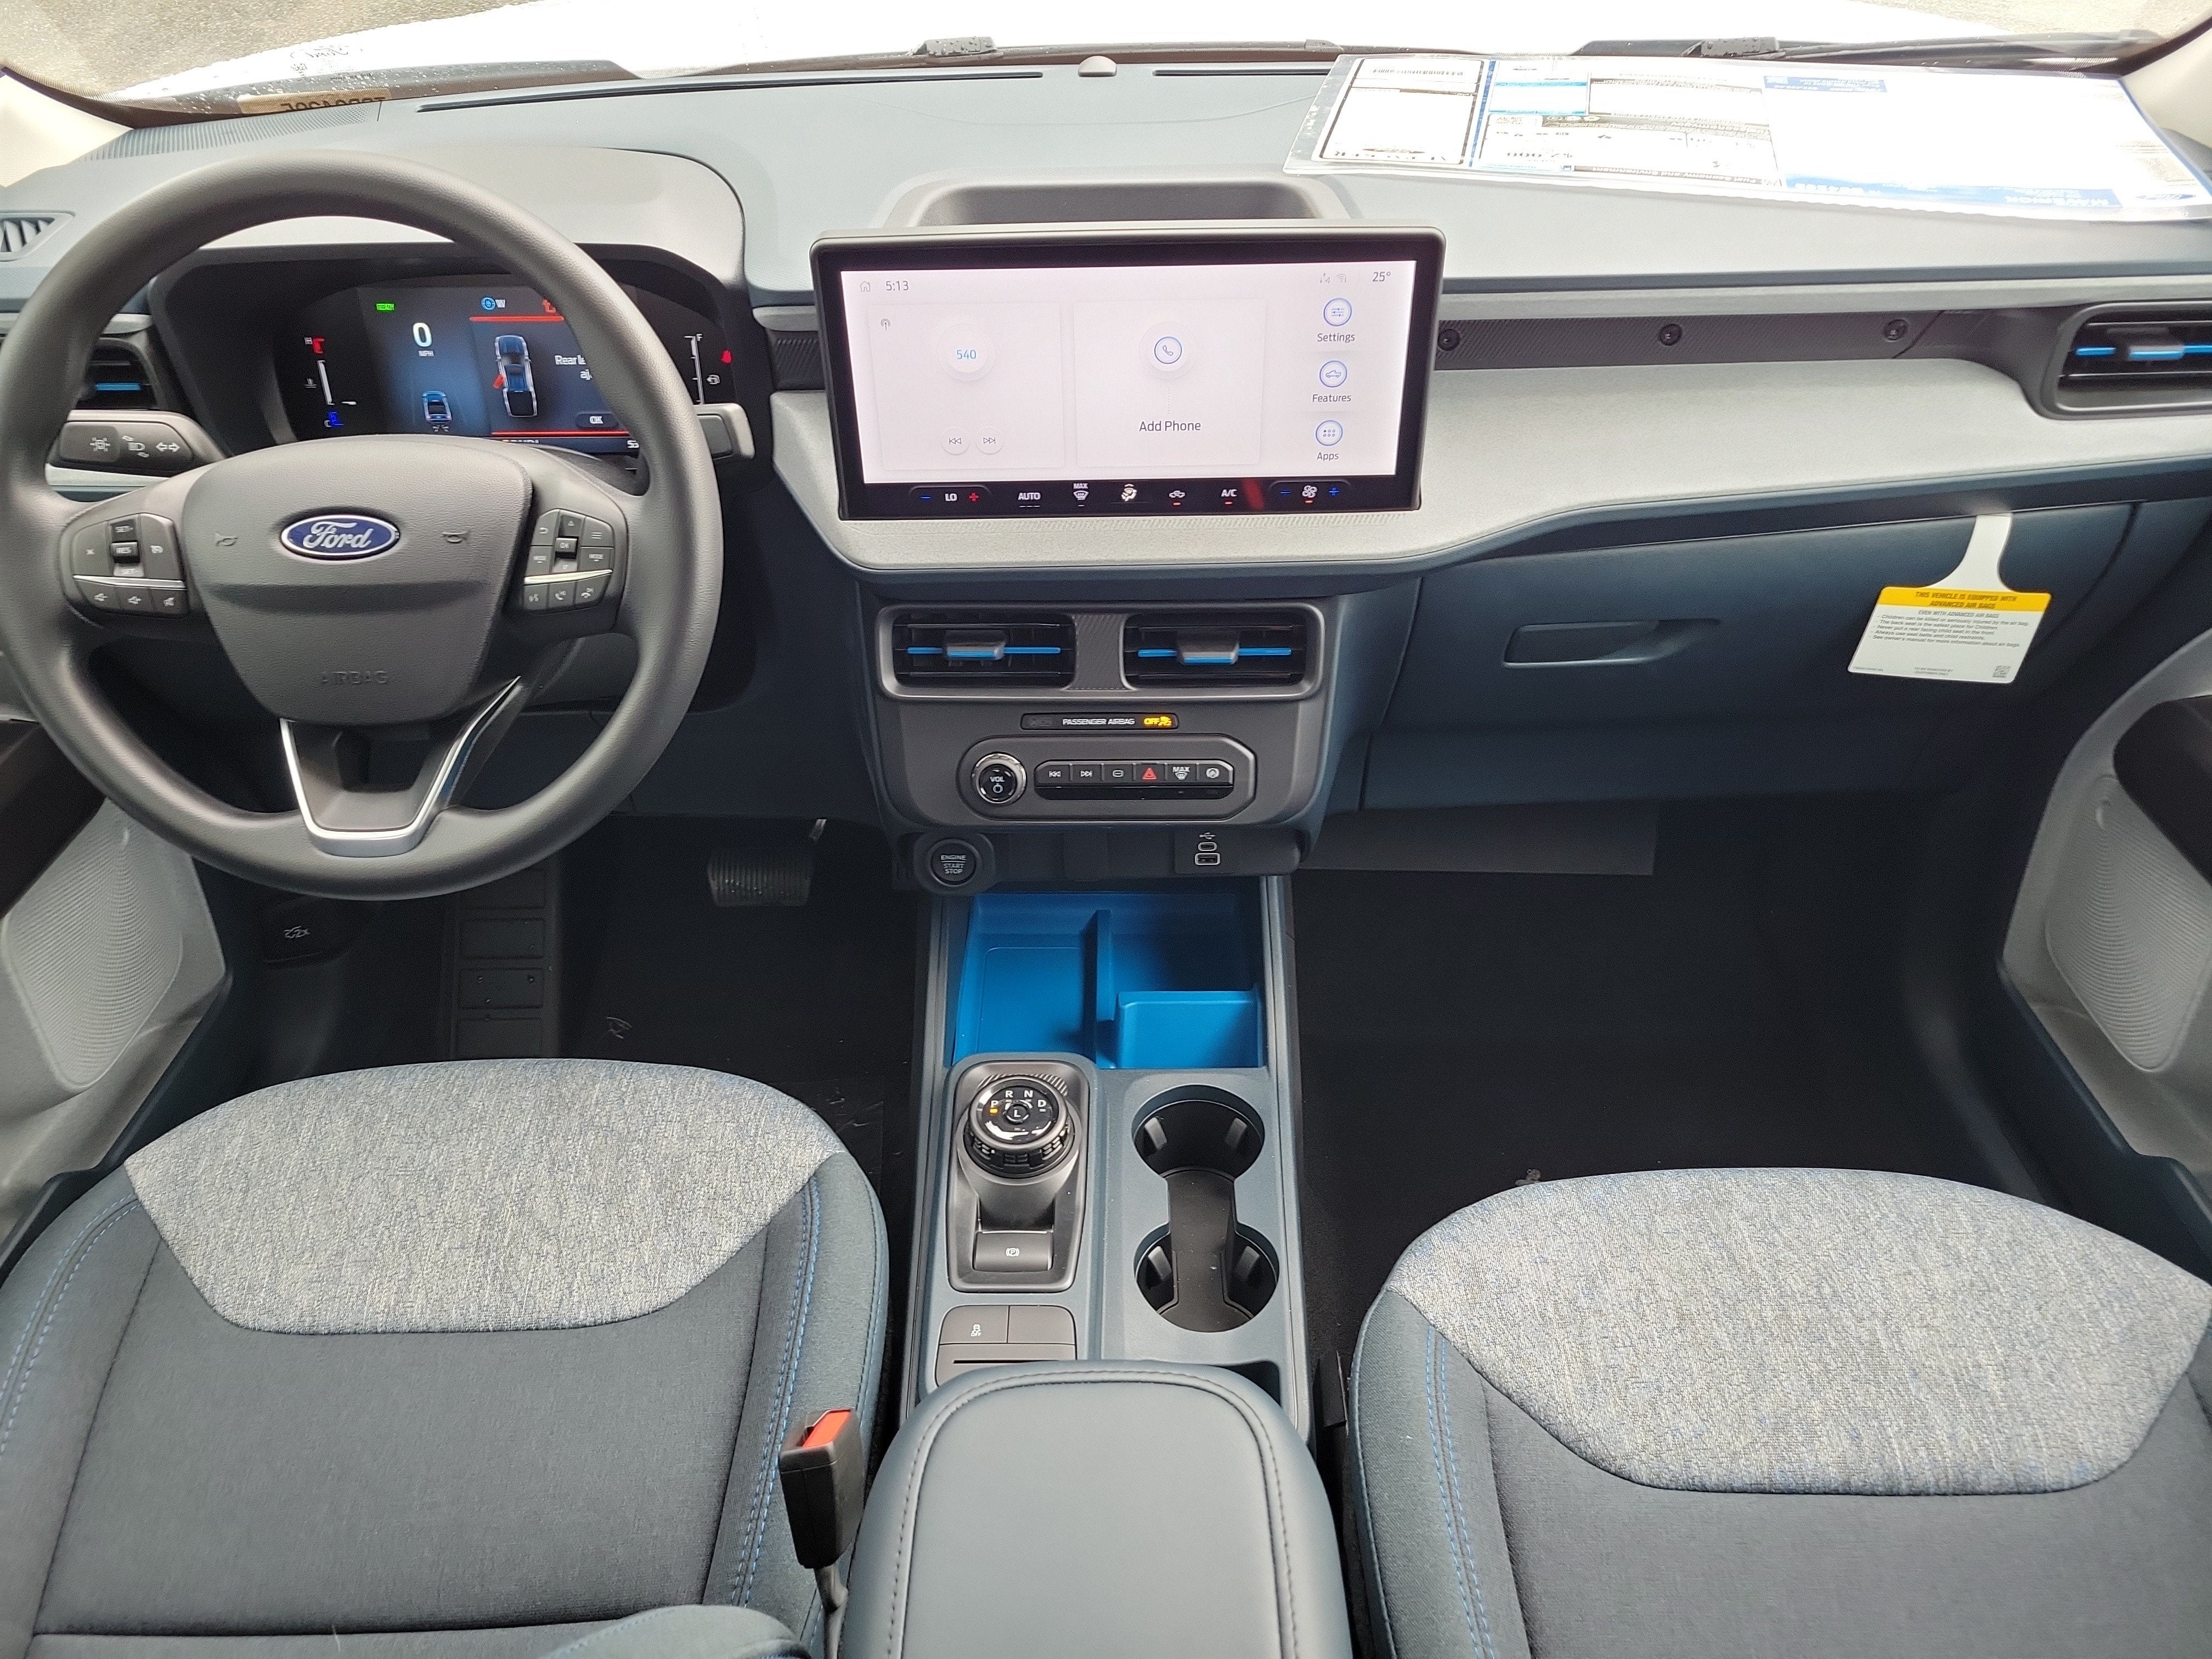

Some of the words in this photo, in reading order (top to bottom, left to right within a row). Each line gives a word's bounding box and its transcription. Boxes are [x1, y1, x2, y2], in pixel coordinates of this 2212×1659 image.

[1372, 271, 1391, 282] 25°
[885, 280, 909, 291] 5:13
[413, 322, 432, 347] 0
[1317, 332, 1355, 343] Settings
[554, 355, 577, 365] Rear
[956, 349, 977, 360] 540
[1312, 393, 1352, 402] Features
[1139, 420, 1162, 432] Add
[1165, 420, 1201, 431] Phone
[1316, 452, 1339, 461] Apps
[945, 493, 958, 501] LO
[1221, 489, 1238, 498] A/C
[302, 521, 375, 549] Ford
[990, 1099, 999, 1108] P
[1005, 1090, 1014, 1098] R
[1023, 1090, 1034, 1098] N
[1037, 1099, 1047, 1108] D
[1013, 1109, 1021, 1118] L
